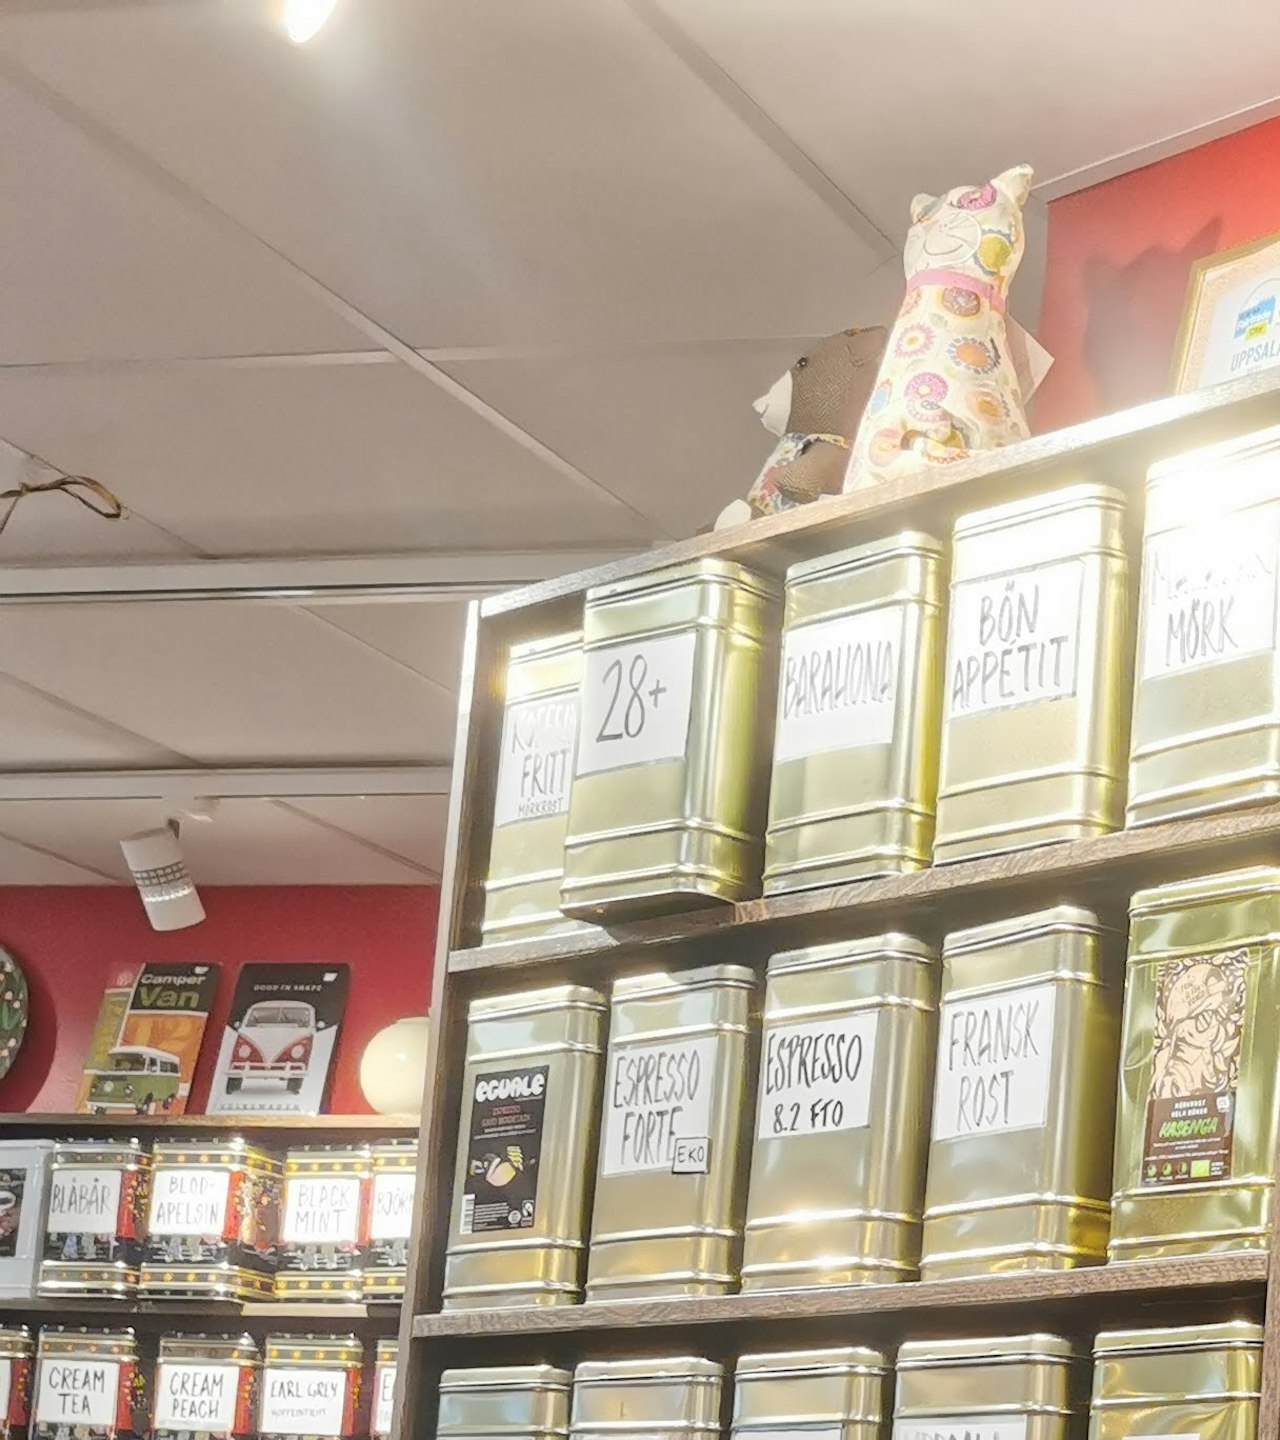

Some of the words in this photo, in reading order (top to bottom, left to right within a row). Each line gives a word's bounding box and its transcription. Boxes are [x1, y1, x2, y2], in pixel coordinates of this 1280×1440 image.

[1166, 596, 1239, 668] MÖRK
[783, 640, 893, 722] BARAHONA
[596, 656, 667, 743] 28+
[521, 748, 570, 798] FRITT
[140, 972, 207, 985] Camper
[138, 986, 200, 1008] Van
[948, 999, 1041, 1071] FRANSK
[765, 1033, 862, 1095] ESPRESSO
[613, 1050, 701, 1110] ESPRESSO
[957, 1070, 1016, 1133] ROST
[772, 1106, 798, 1134] 8.2
[621, 1106, 684, 1165] FORTE
[677, 1144, 705, 1164] EKO
[168, 1175, 214, 1195] BLOD-
[298, 1183, 351, 1208] BLACK
[155, 1201, 220, 1226] APELSIN
[294, 1209, 345, 1235] MINT
[48, 1366, 106, 1394] CREAM
[169, 1373, 224, 1397] CREAM
[270, 1379, 304, 1399] EARL
[308, 1381, 338, 1400] GREY
[58, 1392, 92, 1416] TEA
[172, 1398, 220, 1420] PEACH
